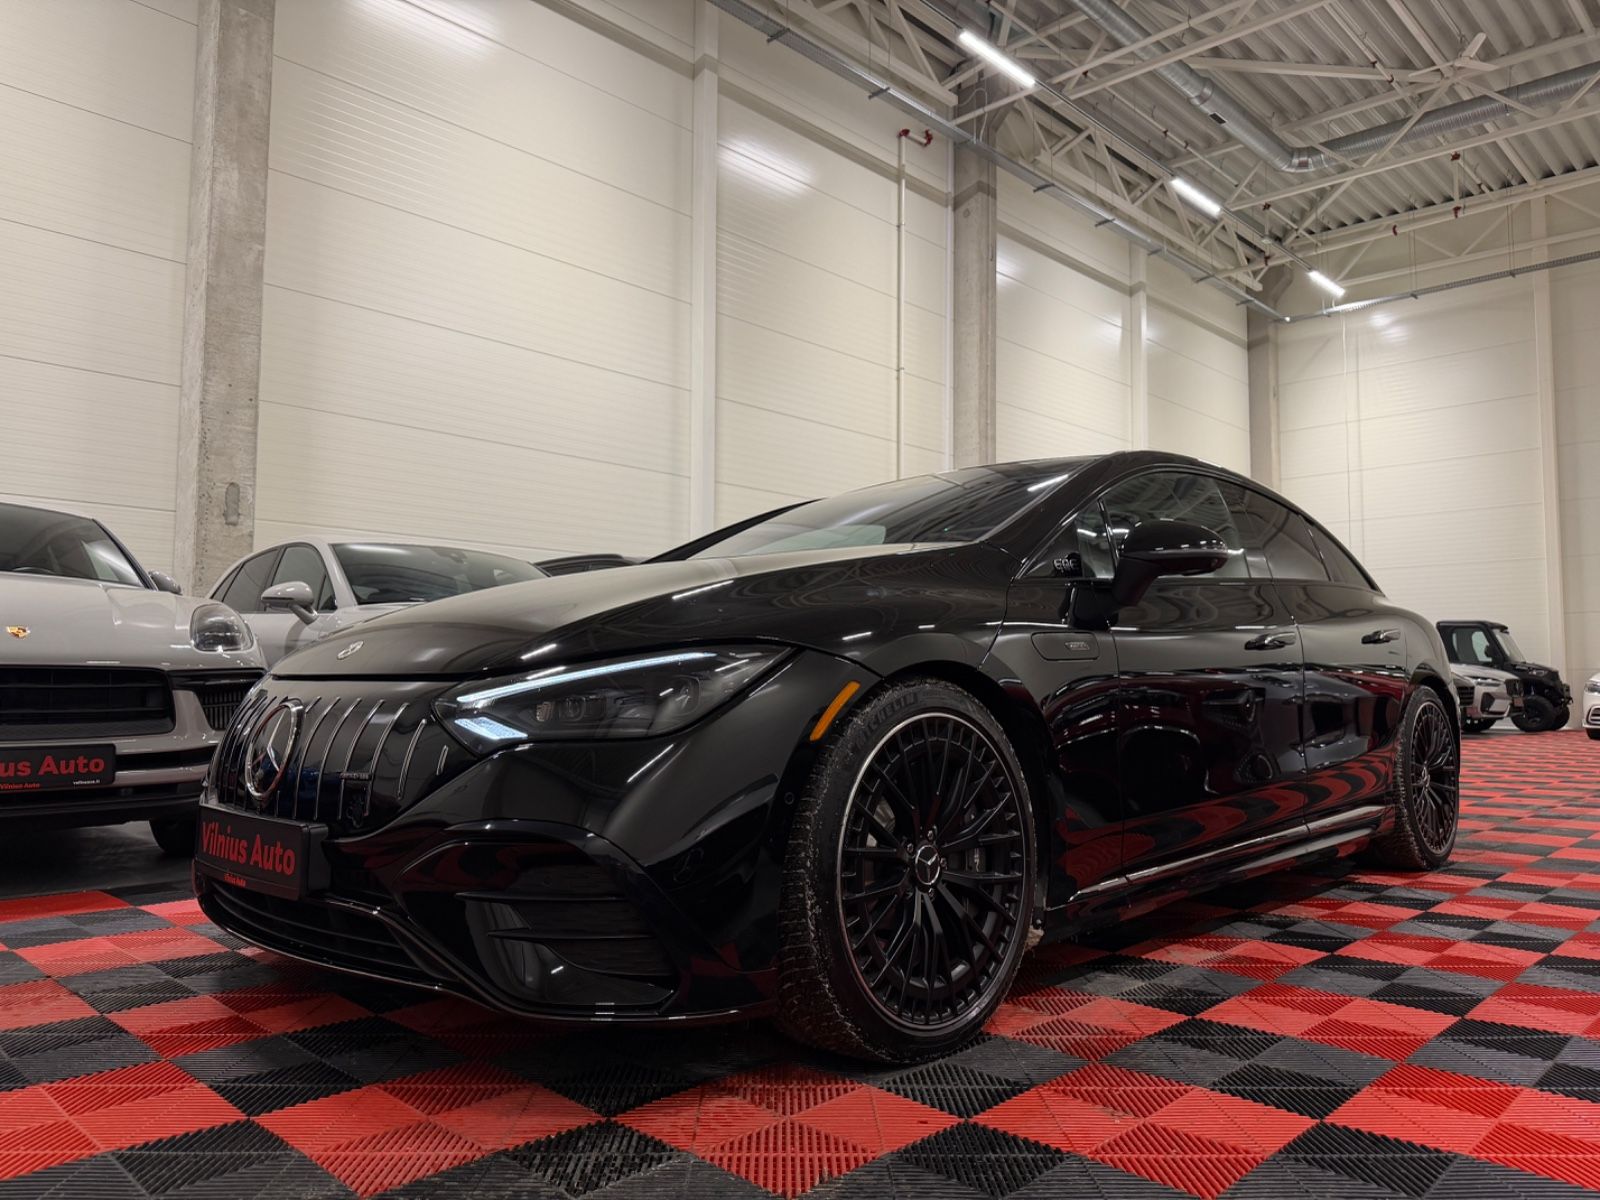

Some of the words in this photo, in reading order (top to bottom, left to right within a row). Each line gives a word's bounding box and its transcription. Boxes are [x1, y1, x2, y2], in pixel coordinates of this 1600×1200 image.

[38, 755, 104, 776] Auto
[202, 821, 247, 865] Vilnius
[250, 833, 296, 876] Auto
